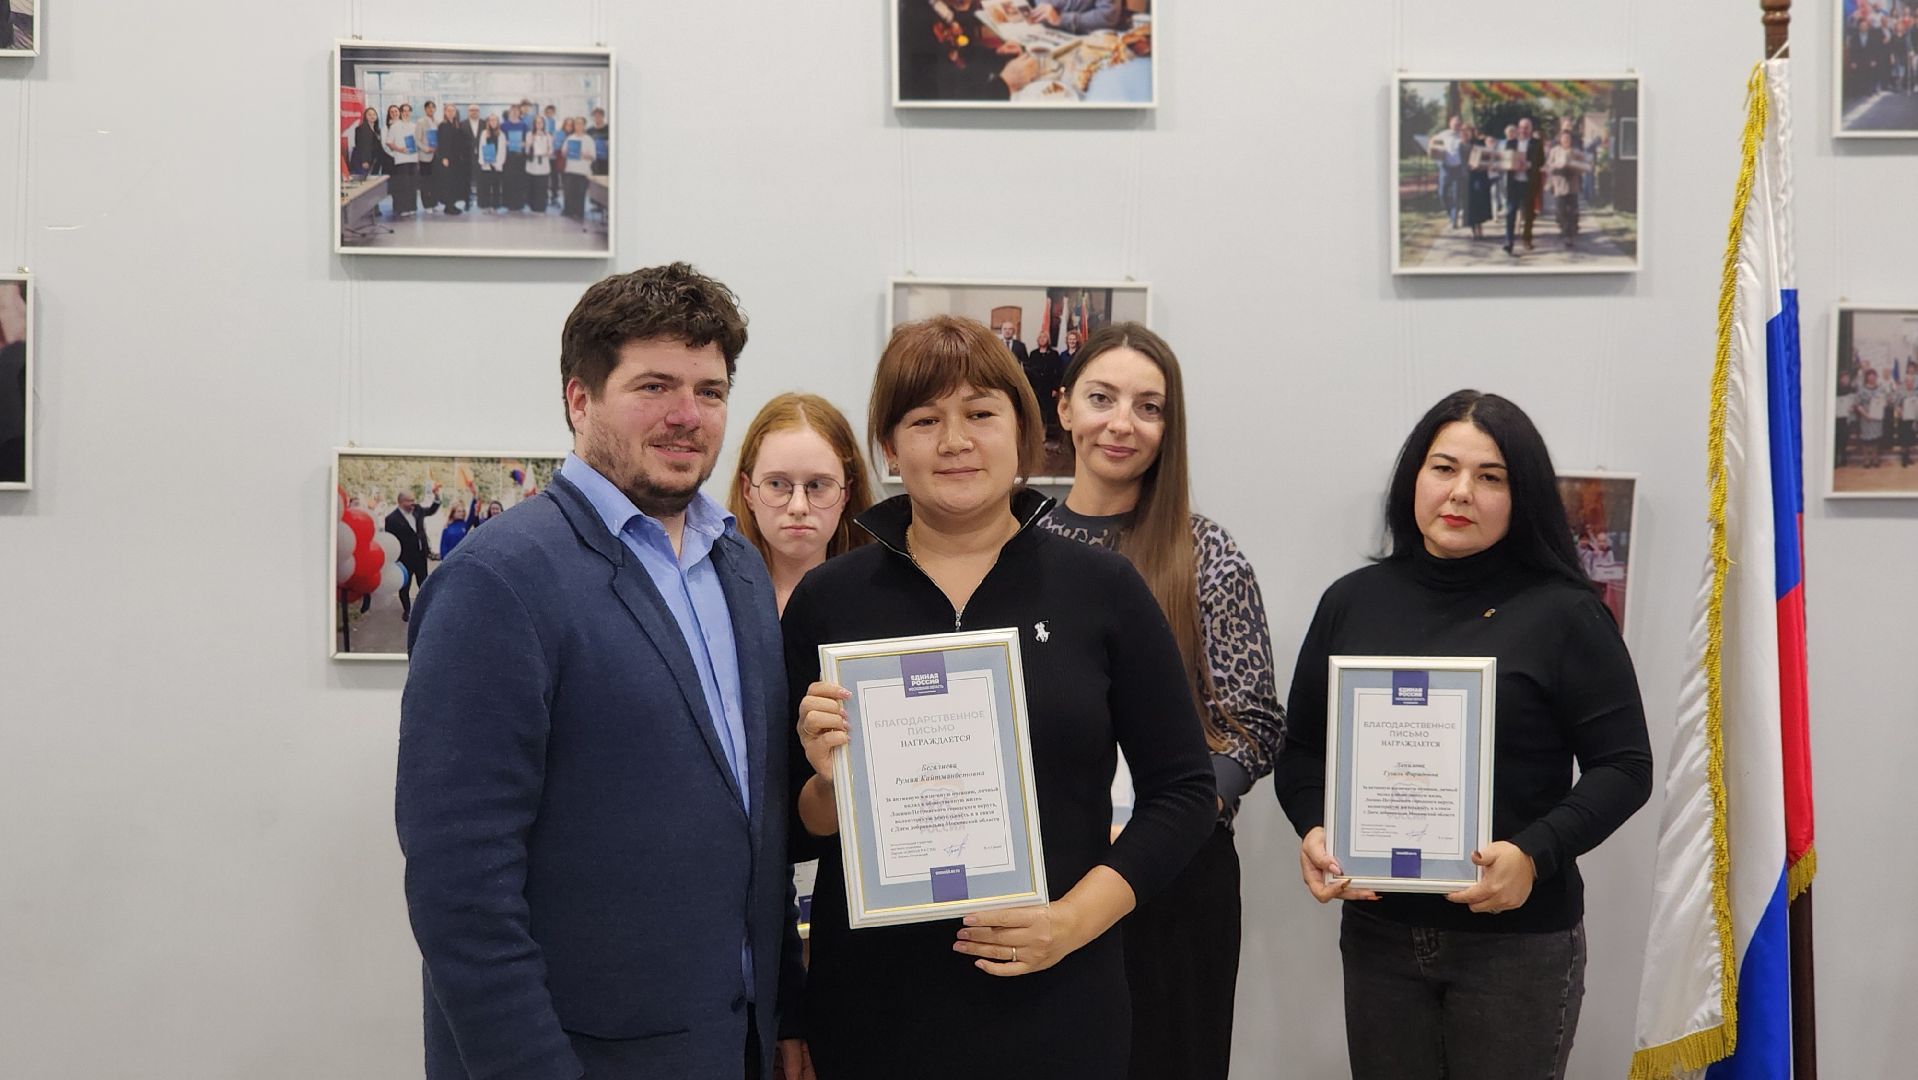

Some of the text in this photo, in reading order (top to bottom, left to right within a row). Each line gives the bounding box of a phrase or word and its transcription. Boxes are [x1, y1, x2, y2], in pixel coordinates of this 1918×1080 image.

[911, 678, 939, 686] РОССИЯ
[874, 710, 984, 728] БЛАГОДАРСТВЕННОЕ
[907, 724, 954, 734] ПИСЬМО
[1363, 721, 1456, 729] БЛАГОДАРСТВЕННОЕ
[900, 734, 970, 747] НАГРАЖДАЕТСЯ
